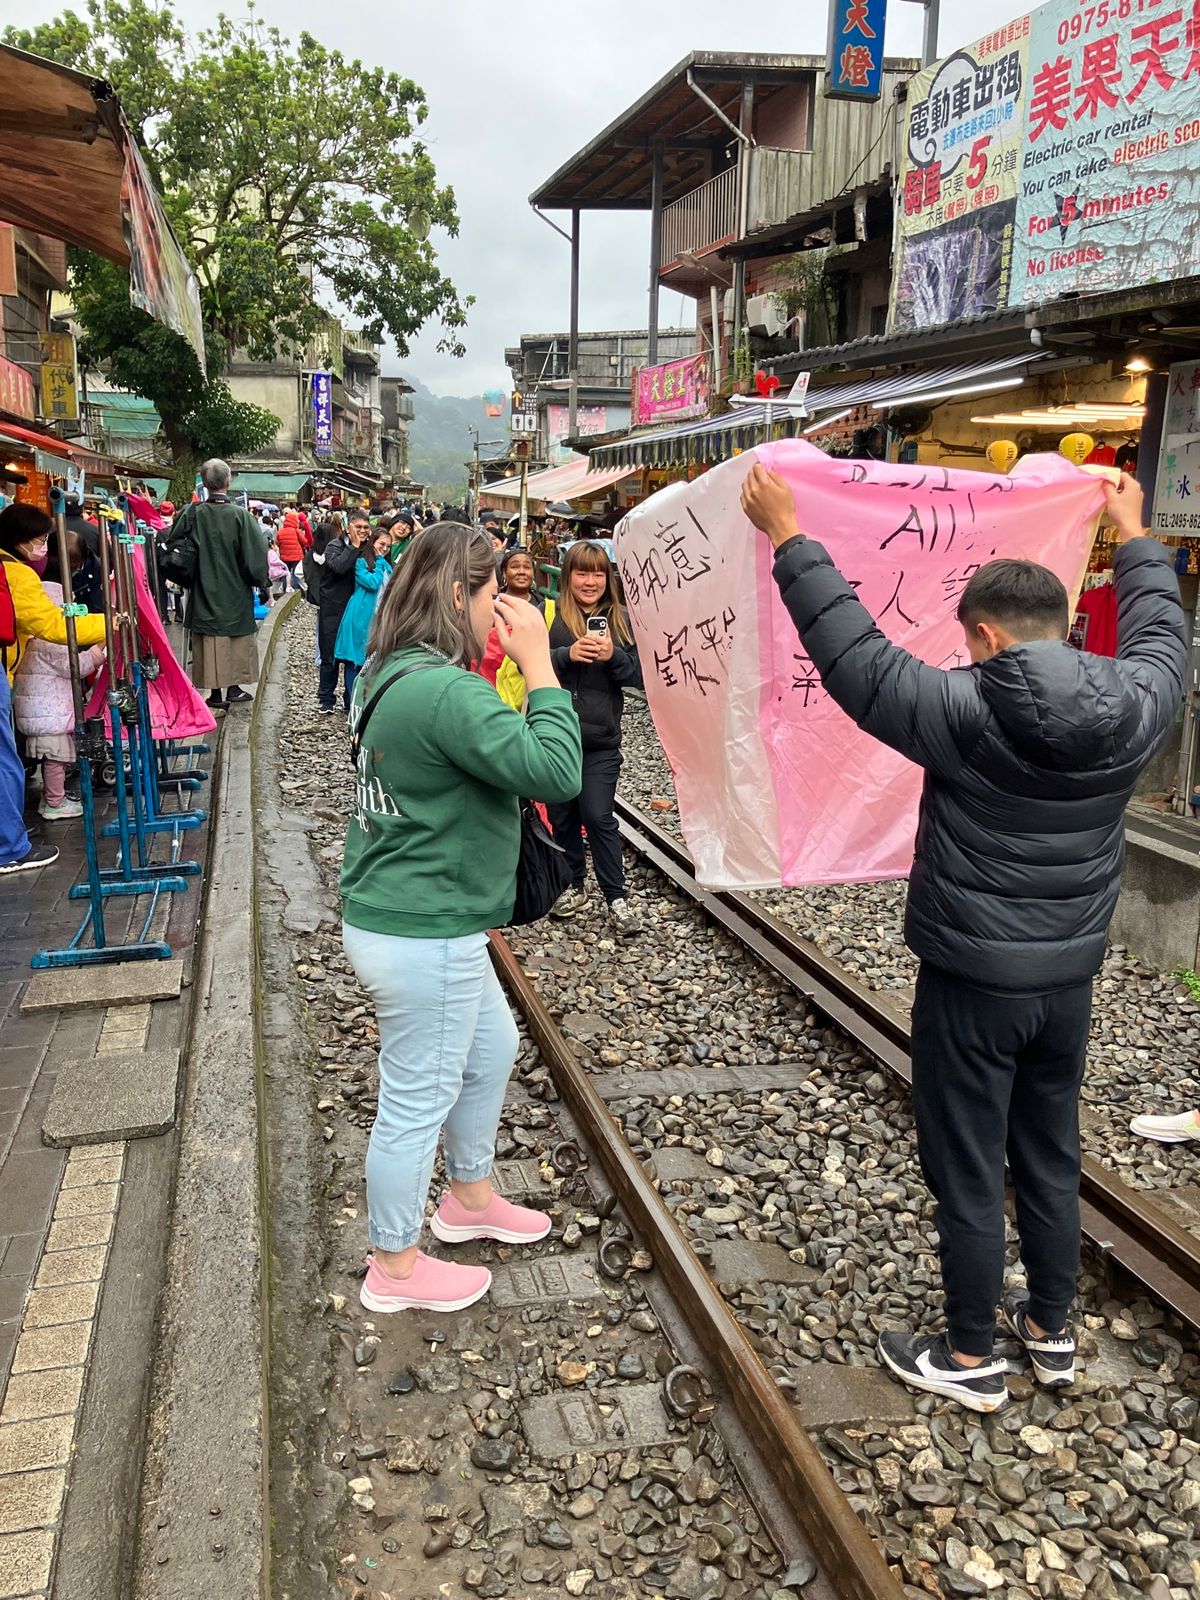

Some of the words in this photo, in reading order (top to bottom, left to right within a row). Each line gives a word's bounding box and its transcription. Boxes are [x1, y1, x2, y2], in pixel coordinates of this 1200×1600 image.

[840, 0, 876, 87] 天燈
[909, 50, 1020, 141] 電動車出租
[966, 135, 993, 189] 5
[990, 149, 1018, 178] 分鐘
[1022, 179, 1045, 198] You
[1047, 169, 1072, 189] can
[1075, 157, 1108, 179] take
[1113, 129, 1169, 165] electric
[1023, 137, 1073, 170] Electric
[1077, 128, 1101, 151] car
[1104, 107, 1155, 140] rental
[904, 160, 941, 216] 騎車
[943, 172, 965, 201] 只要
[1028, 214, 1054, 238] For
[1060, 195, 1078, 226] 5
[1082, 182, 1169, 219] minutes
[1026, 257, 1046, 279] No
[1050, 246, 1105, 273] license
[317, 376, 331, 441] 吉祥天燈
[1175, 474, 1191, 500] 冰
